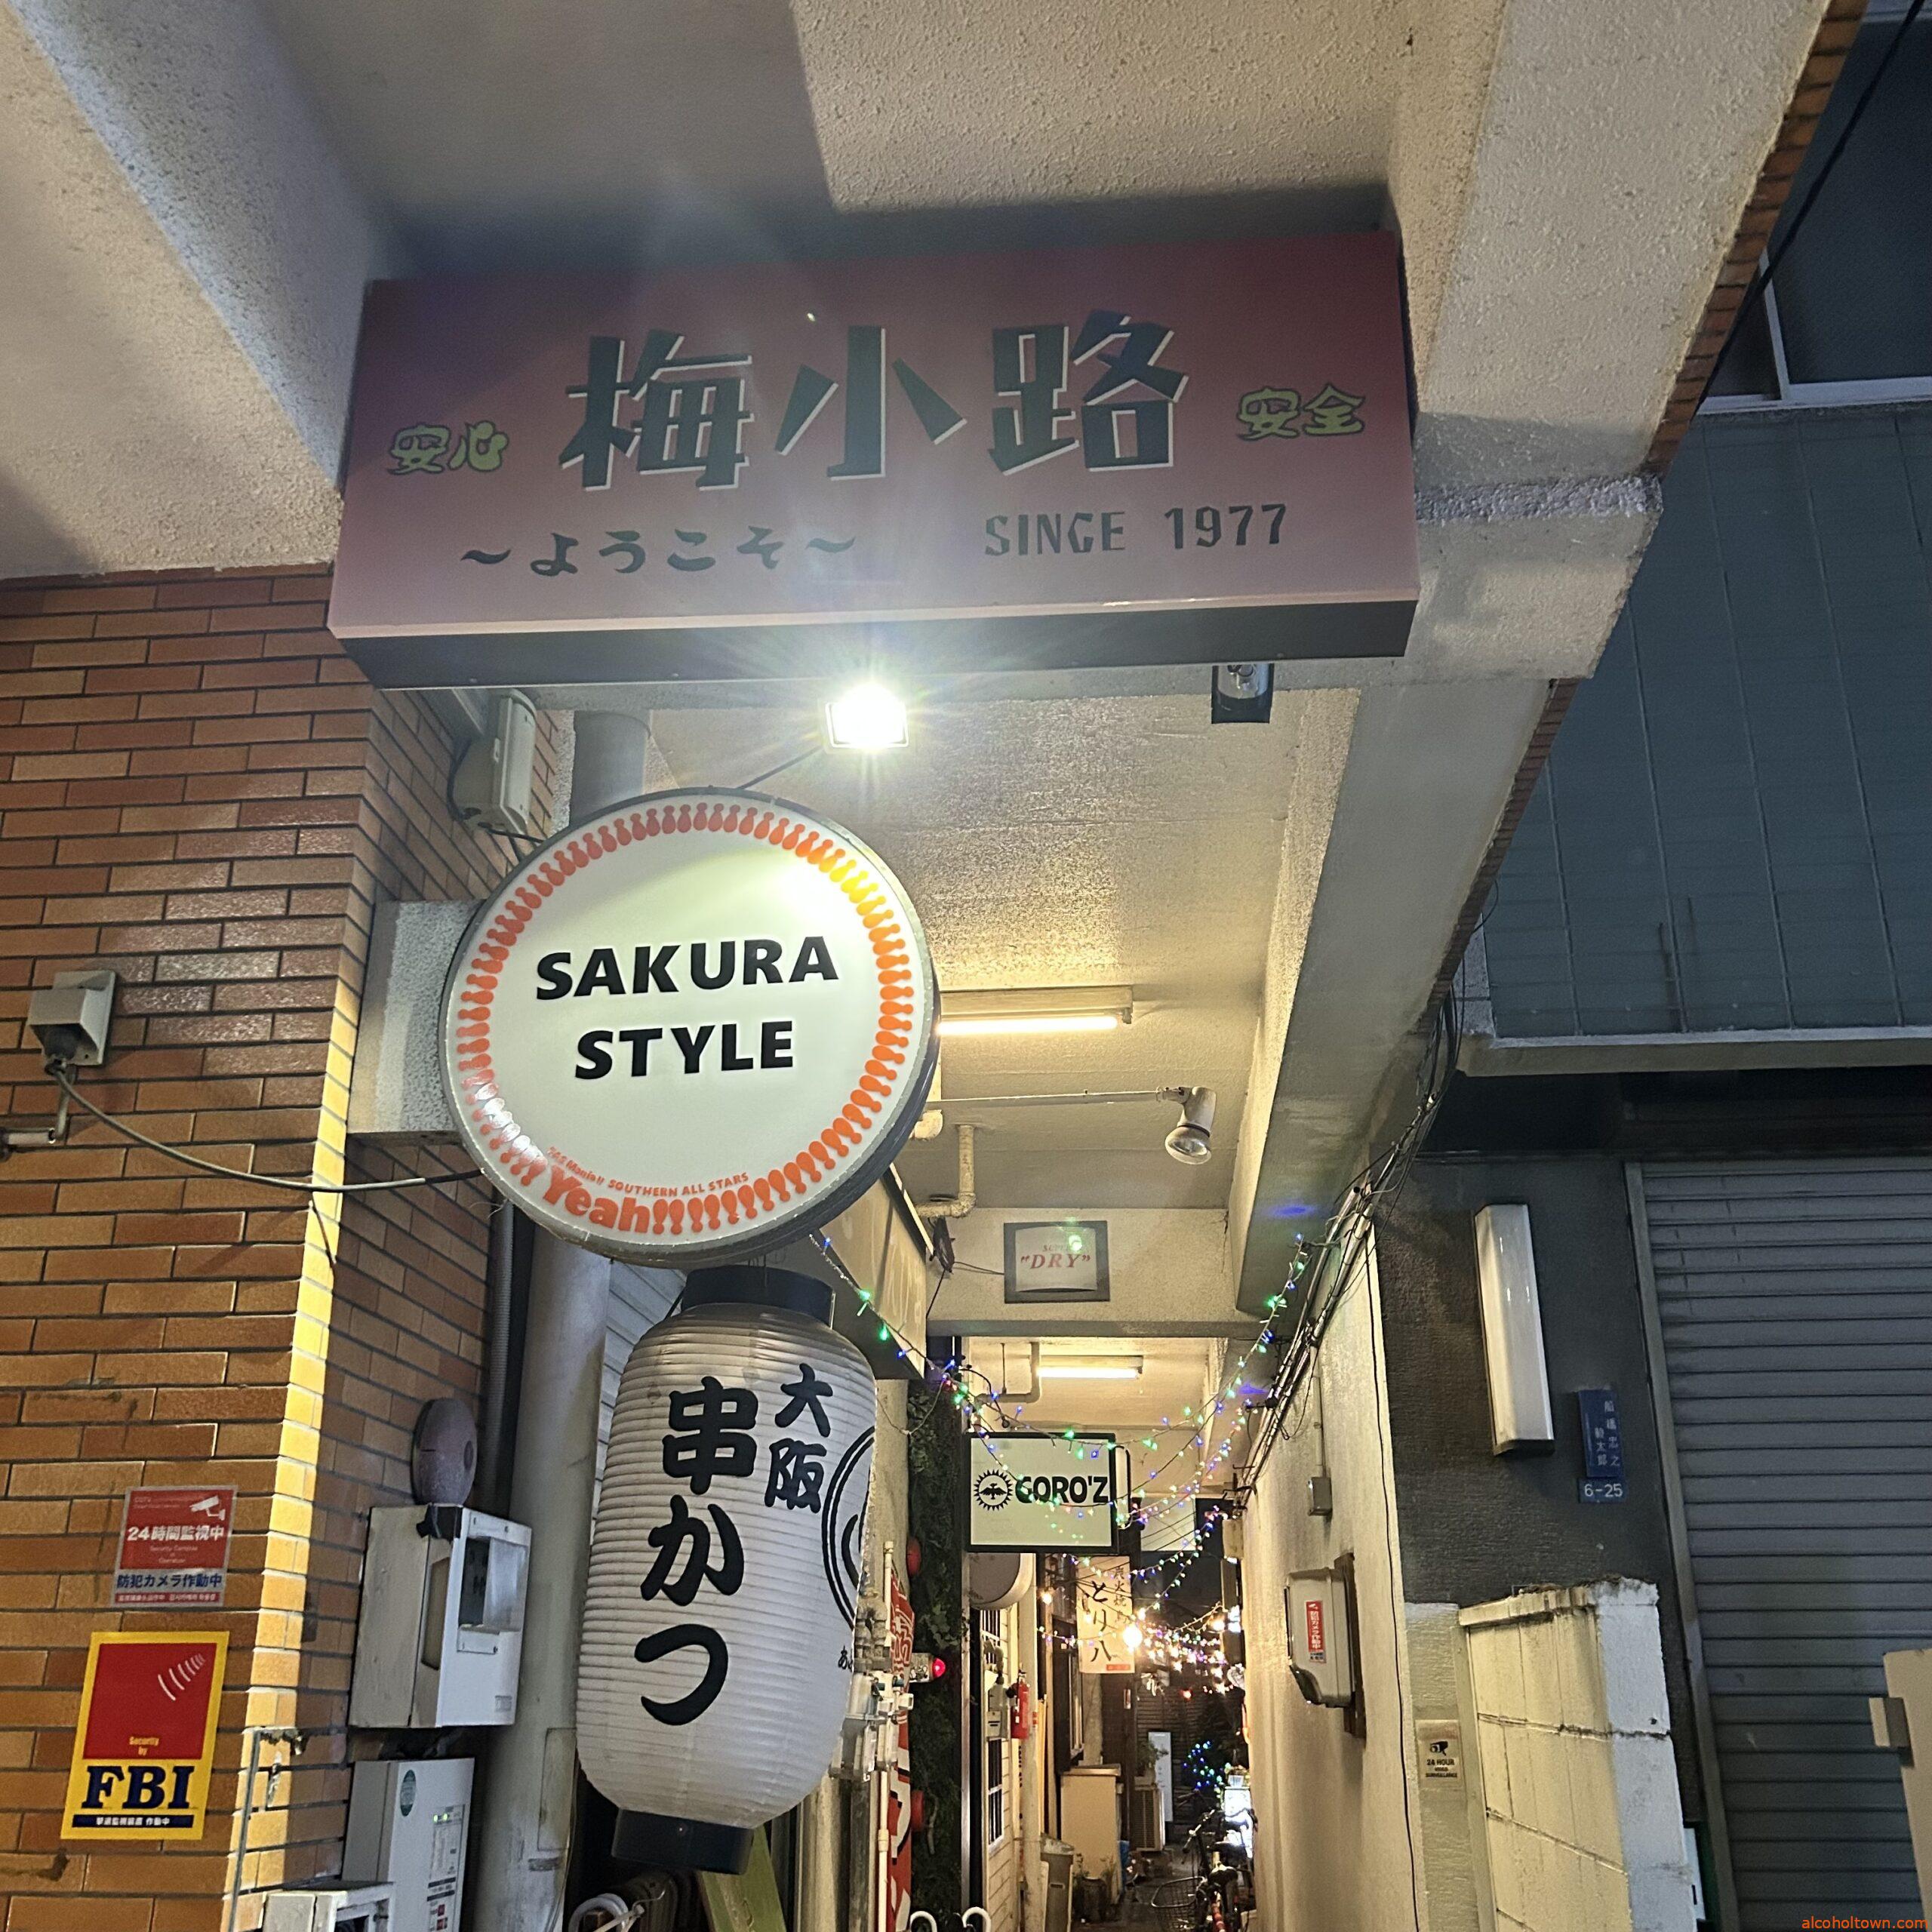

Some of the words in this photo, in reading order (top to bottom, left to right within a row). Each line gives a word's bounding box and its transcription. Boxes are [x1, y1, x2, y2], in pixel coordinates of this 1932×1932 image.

[558, 310, 1189, 491] 梅小路
[1237, 383, 1366, 441] 安全
[387, 420, 509, 475] 安心
[985, 512, 1125, 556] SINCE
[1164, 503, 1287, 550] 1977
[536, 936, 839, 1000] SAKURA
[575, 1020, 794, 1079] STYLE
[608, 1180, 678, 1197] SOUTHERN
[681, 1183, 705, 1195] ALL
[708, 1172, 749, 1191] STARS
[764, 1363, 833, 1513] 大阪
[1584, 1483, 1623, 1498] 6-25
[127, 1524, 224, 1541] 24時間監視中
[634, 1376, 759, 1725] 串かつ
[117, 1574, 223, 1588] 防犯カメラ作動中
[129, 1737, 159, 1746] Security
[82, 1766, 195, 1809] FBI
